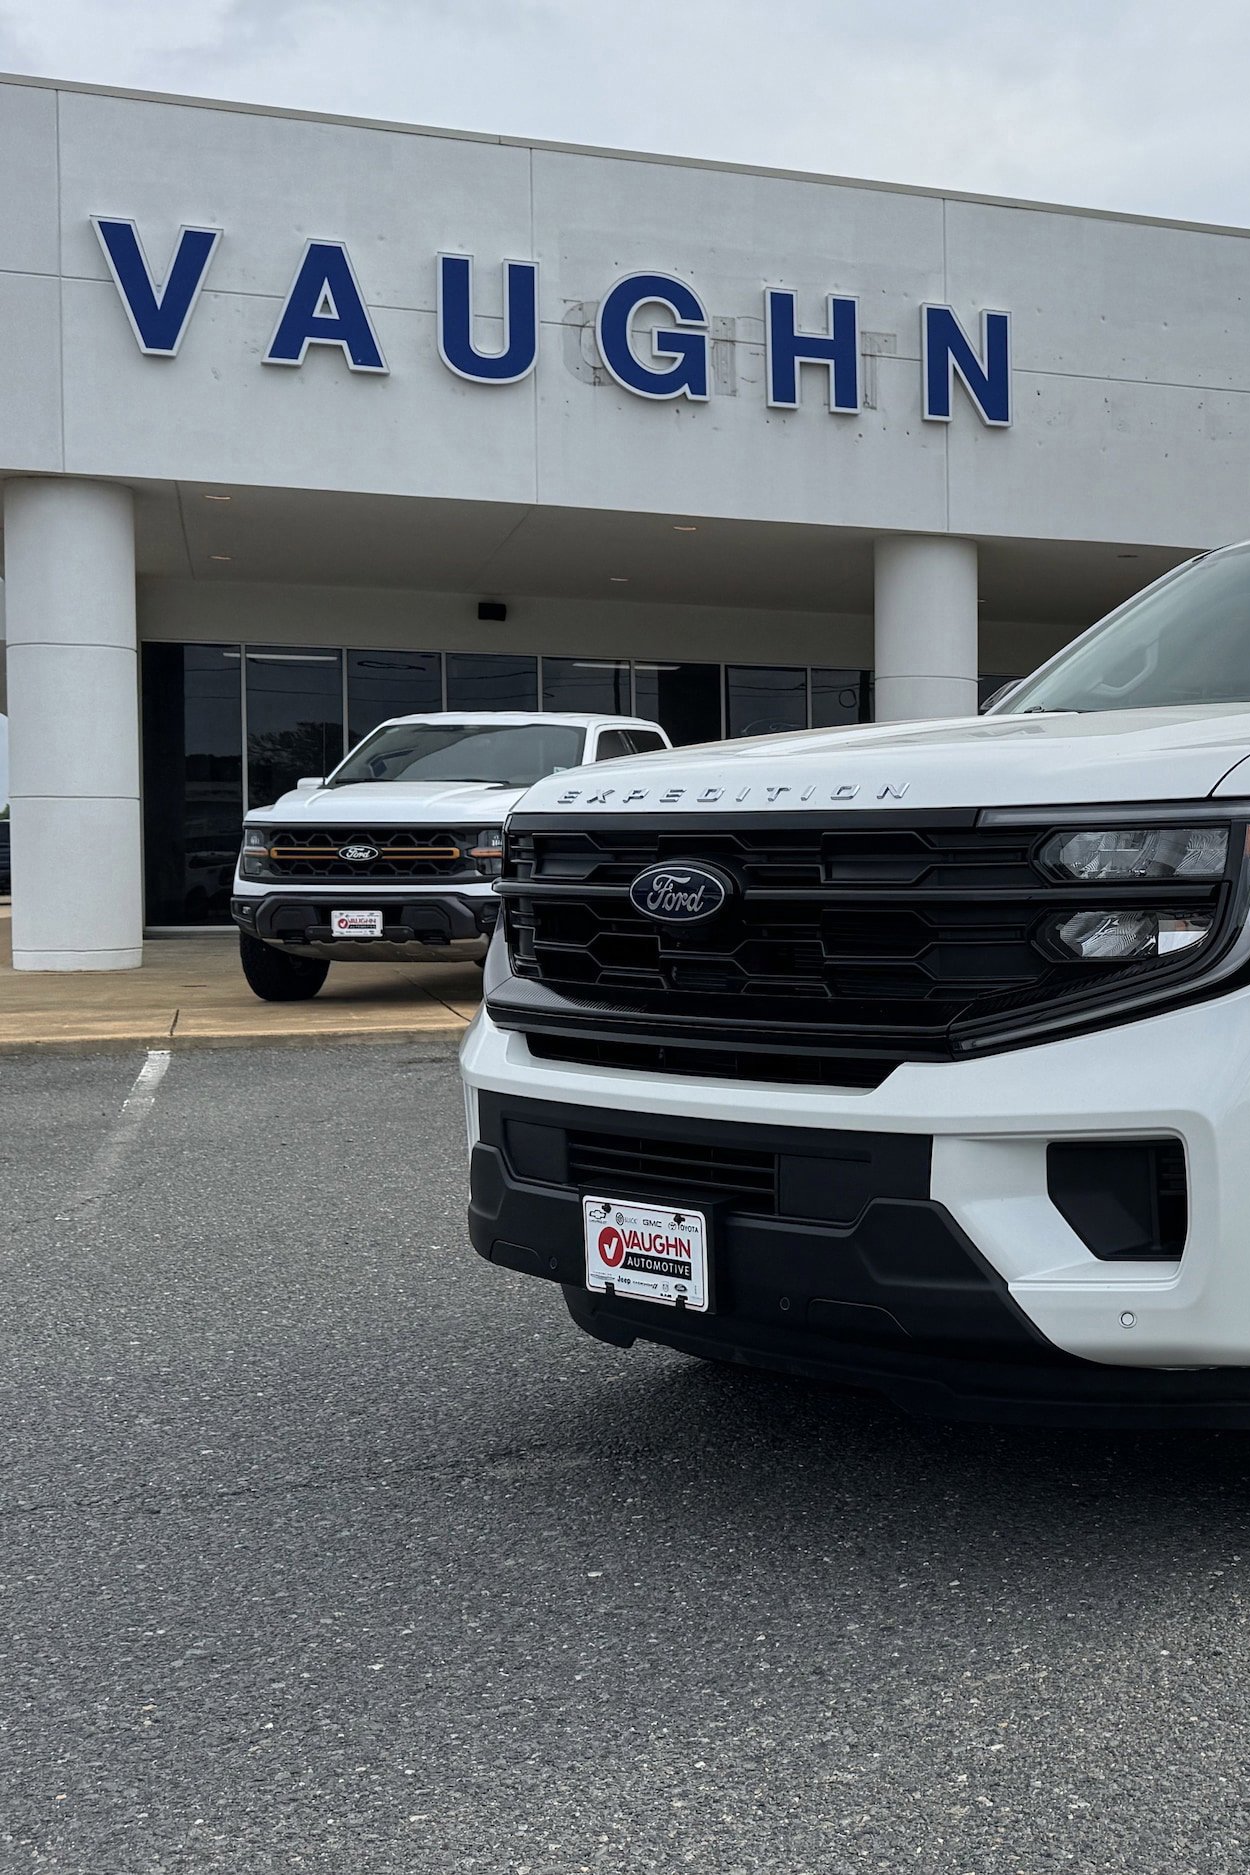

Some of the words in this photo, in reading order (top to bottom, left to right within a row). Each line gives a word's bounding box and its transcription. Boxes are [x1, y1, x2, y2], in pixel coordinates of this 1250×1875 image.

[89, 214, 1012, 428] VAUGHN
[557, 782, 911, 804] EXPEDITION
[346, 847, 371, 858] Ford
[646, 874, 706, 912] Ford
[643, 1219, 662, 1228] GMC
[621, 1229, 691, 1259] VAUGHN
[627, 1256, 690, 1277] AUTOMOTIVE
